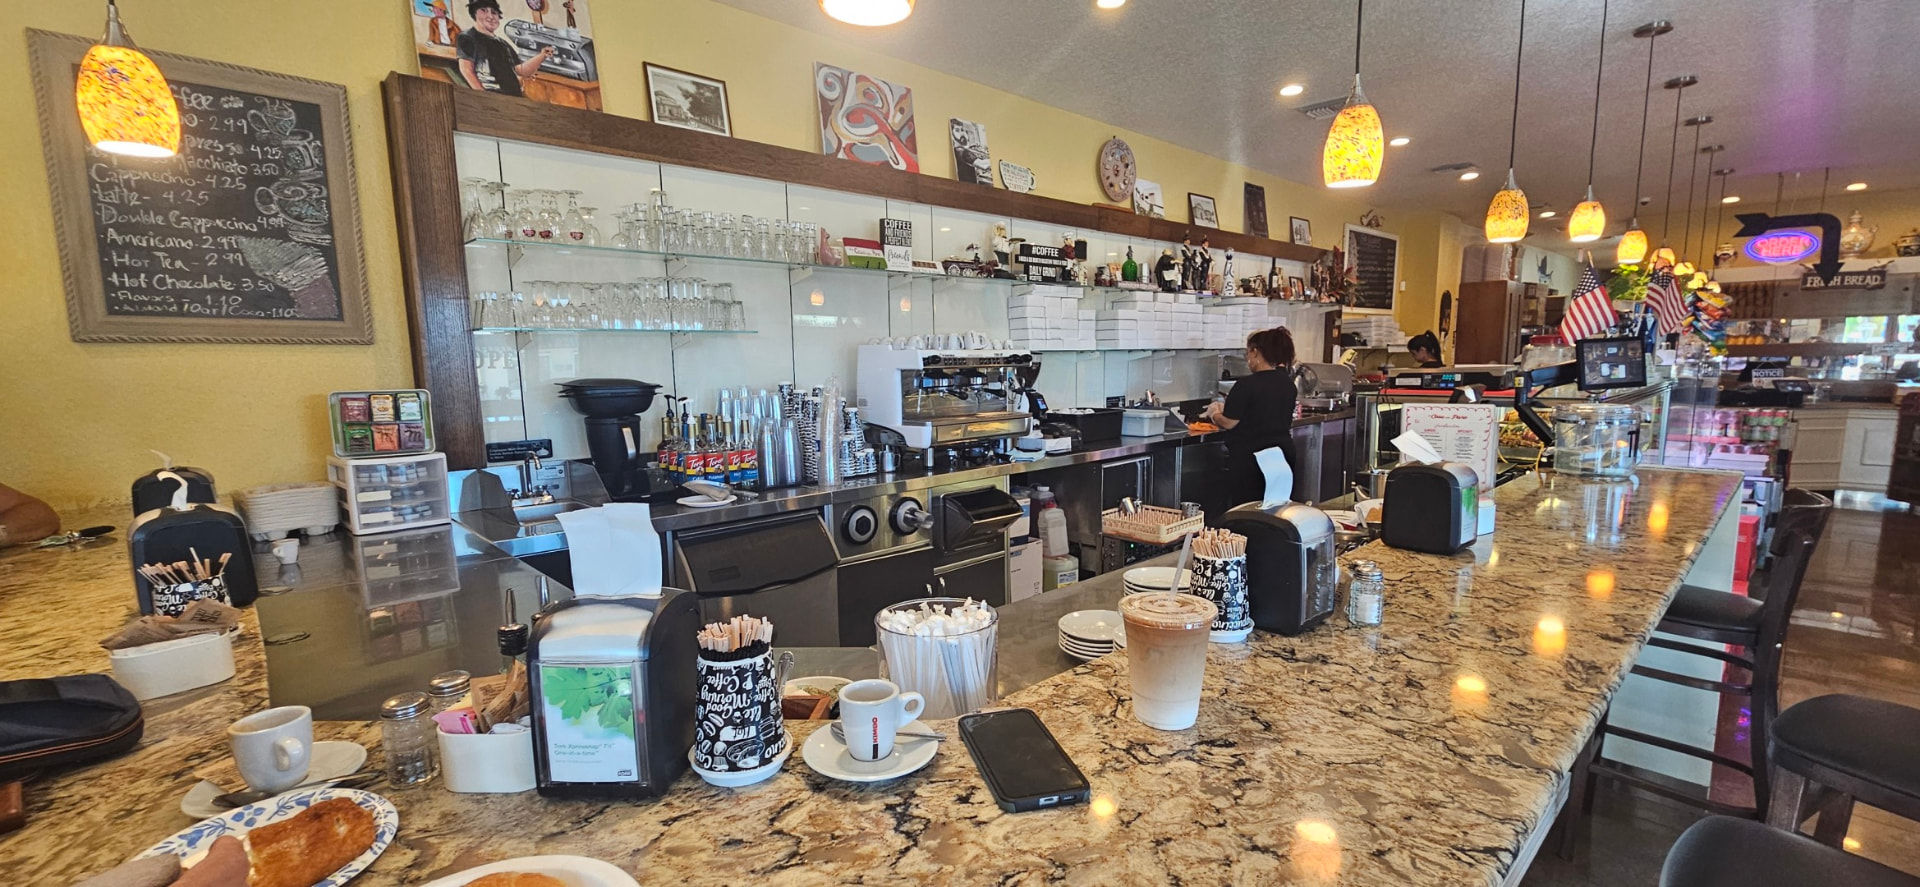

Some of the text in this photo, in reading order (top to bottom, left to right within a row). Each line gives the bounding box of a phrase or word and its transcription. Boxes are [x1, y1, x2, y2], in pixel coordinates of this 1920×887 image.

[162, 189, 210, 207] 4.25
[96, 203, 167, 226] Double
[168, 210, 258, 234] Cappuccino
[884, 220, 912, 230] COFFEE
[894, 229, 912, 238] FRIENDS
[1755, 235, 1811, 248] ORDER
[1032, 246, 1059, 257] #COFFEE
[1760, 246, 1801, 257] HERE
[152, 251, 191, 272] Tea
[108, 271, 149, 289] Hot
[1844, 274, 1881, 286] BREAD
[117, 290, 242, 306] Flavors 1.10
[1210, 581, 1231, 592] Coffee
[706, 673, 740, 693] Coffee
[701, 685, 751, 710] Morning
[754, 686, 776, 703] Coffee
[705, 702, 733, 719] Good
